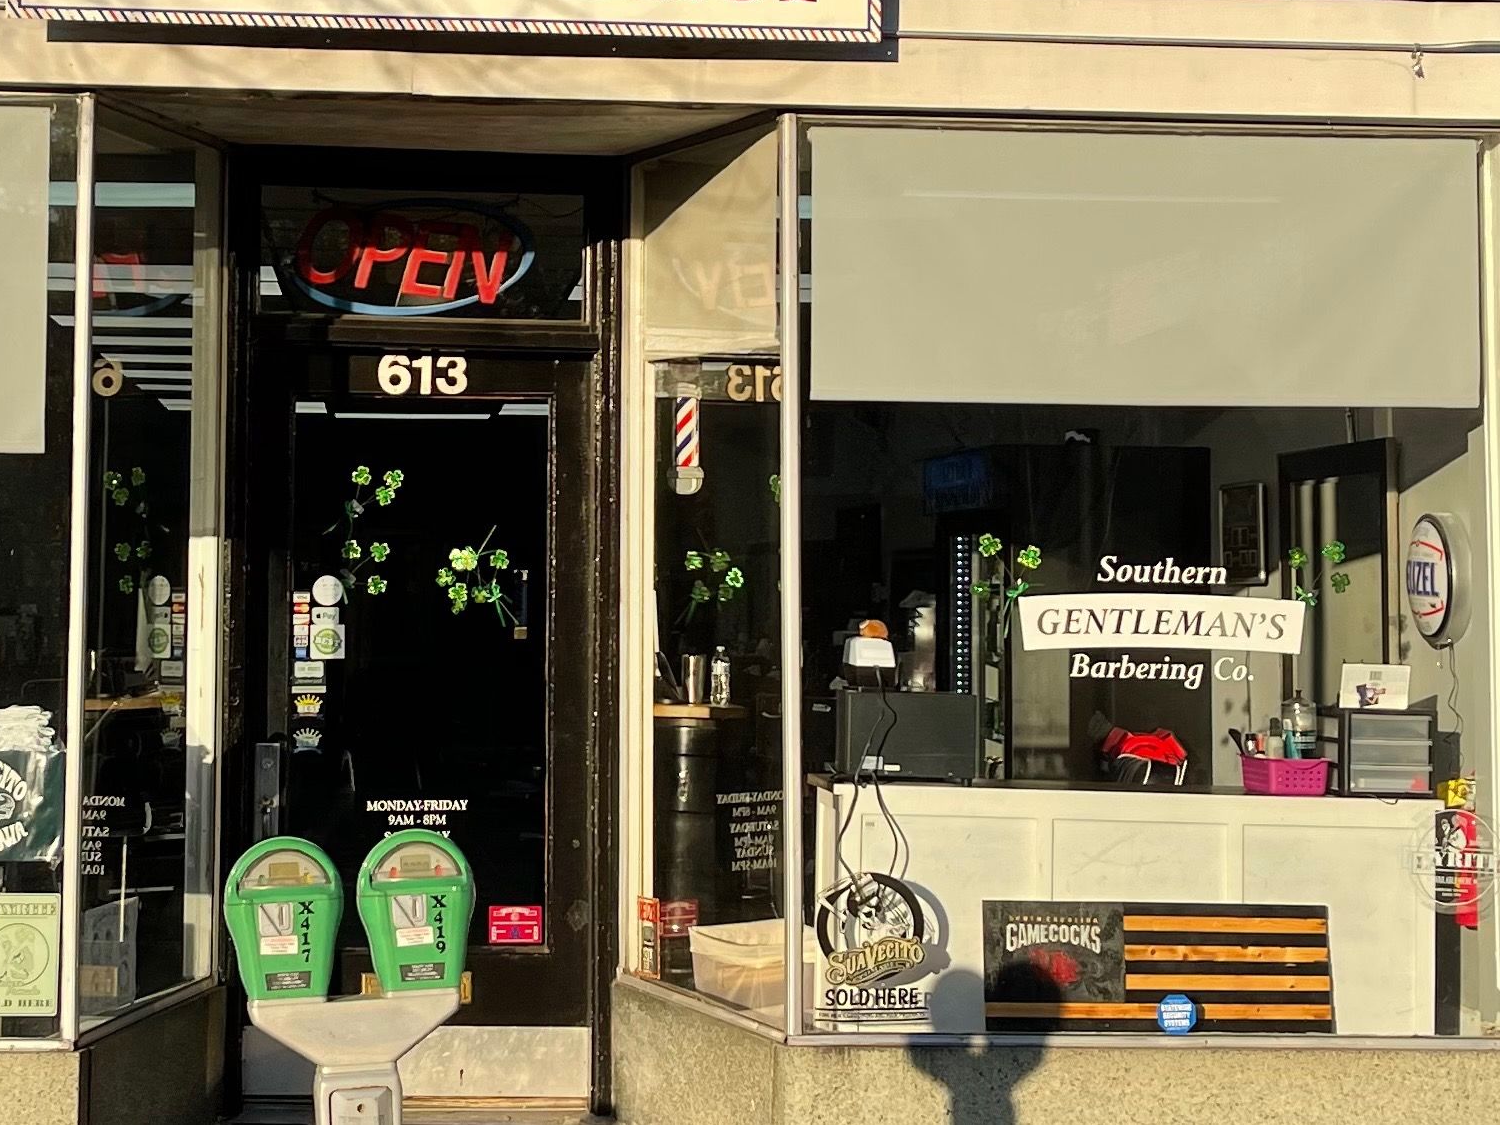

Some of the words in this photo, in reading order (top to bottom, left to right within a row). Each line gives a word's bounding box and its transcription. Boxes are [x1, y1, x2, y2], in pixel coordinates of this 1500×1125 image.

[297, 205, 517, 305] OPEN
[377, 354, 468, 395] 613
[1097, 555, 1227, 585] Southern
[1037, 608, 1287, 640] GENTLEMAN'S
[1069, 652, 1204, 690] Barbering
[1214, 656, 1254, 682] Co.
[366, 799, 469, 811] MONDAY-FRIDAY
[388, 814, 414, 826] 9AM
[422, 814, 447, 825] 8PM
[298, 900, 315, 963] X417
[430, 894, 447, 954] X419
[1005, 923, 1101, 954] GAMECOCKS
[18, 999, 53, 1008] HERE
[825, 988, 870, 1006] SOLD
[876, 987, 919, 1006] HERE
